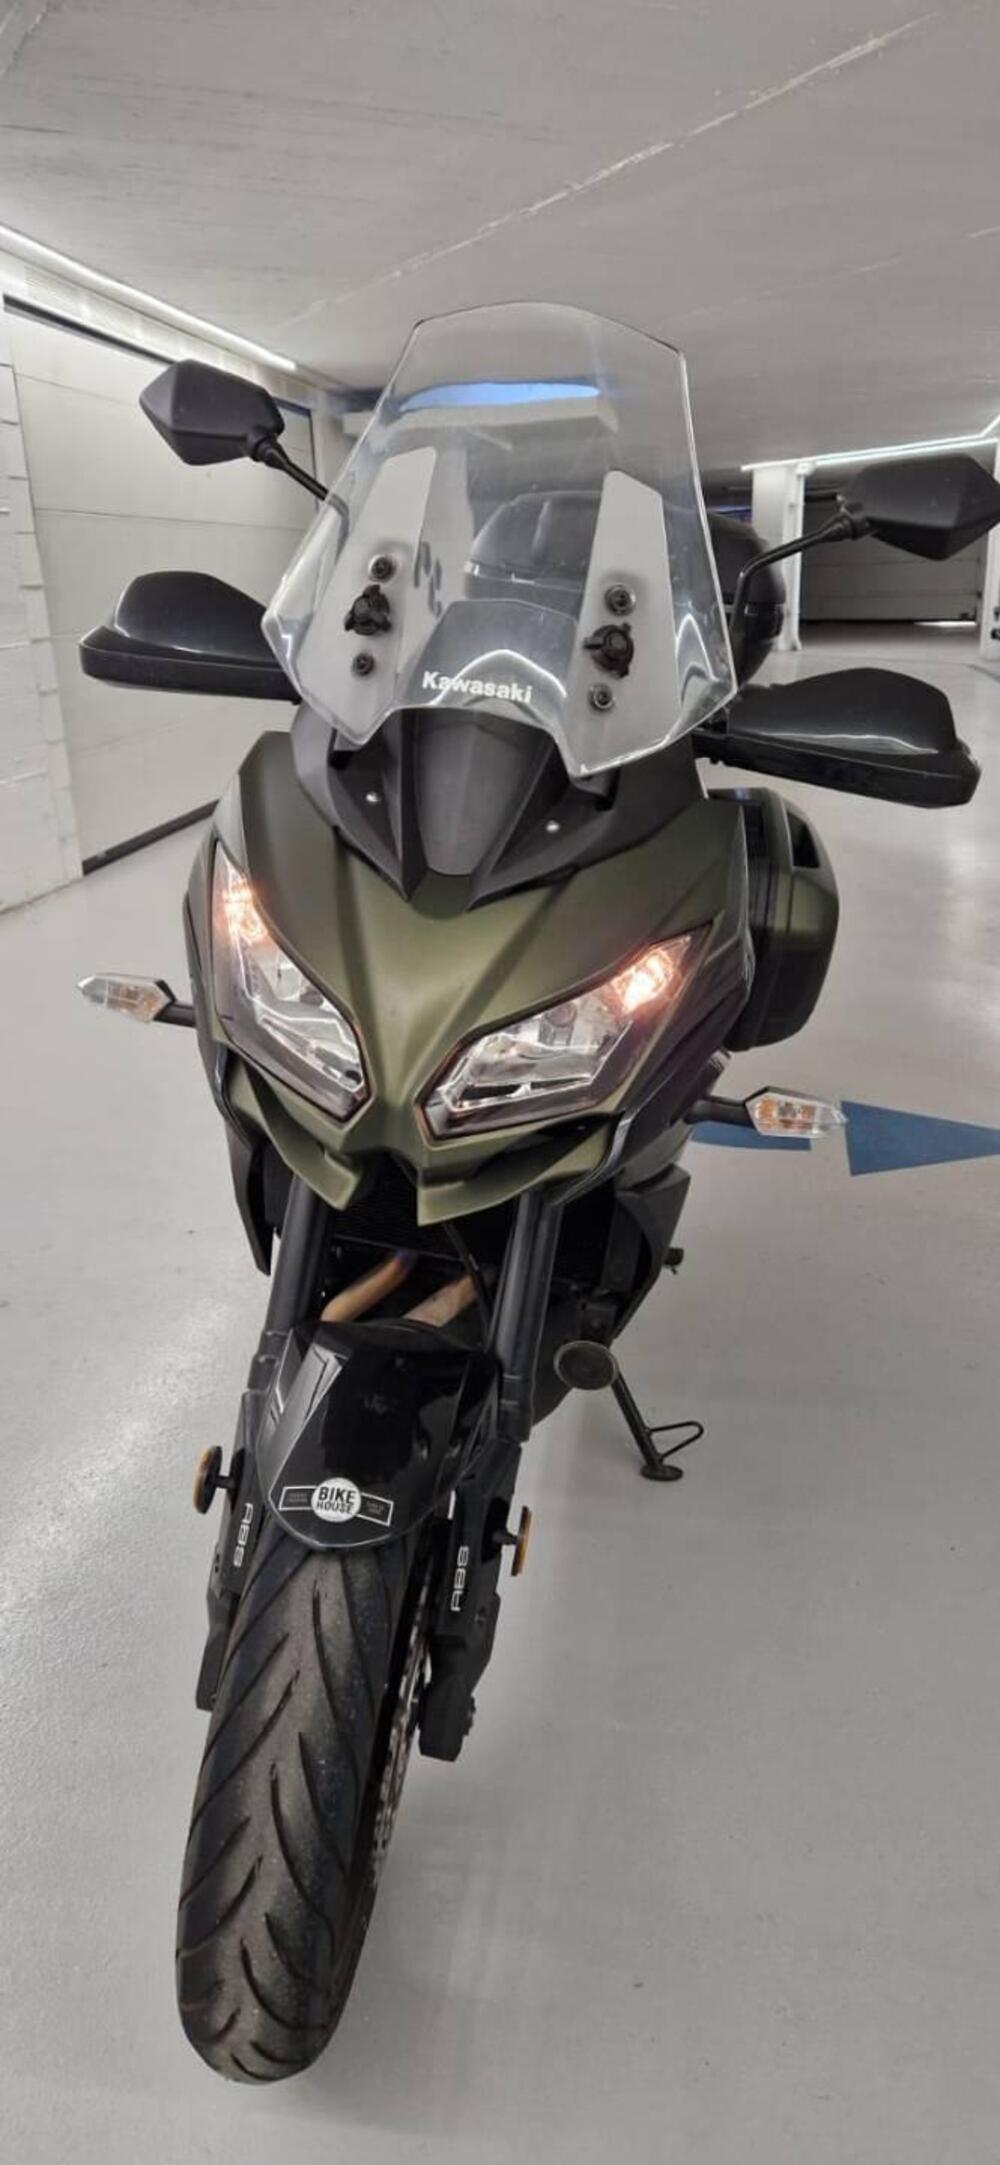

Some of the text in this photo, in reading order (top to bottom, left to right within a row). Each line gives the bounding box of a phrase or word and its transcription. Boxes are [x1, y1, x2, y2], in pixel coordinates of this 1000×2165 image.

[422, 671, 533, 703] Kawasaki
[316, 1501, 355, 1515] HOUSE
[319, 1487, 357, 1504] BIKE
[233, 1503, 253, 1567] ABS
[450, 1545, 469, 1611] ABS
